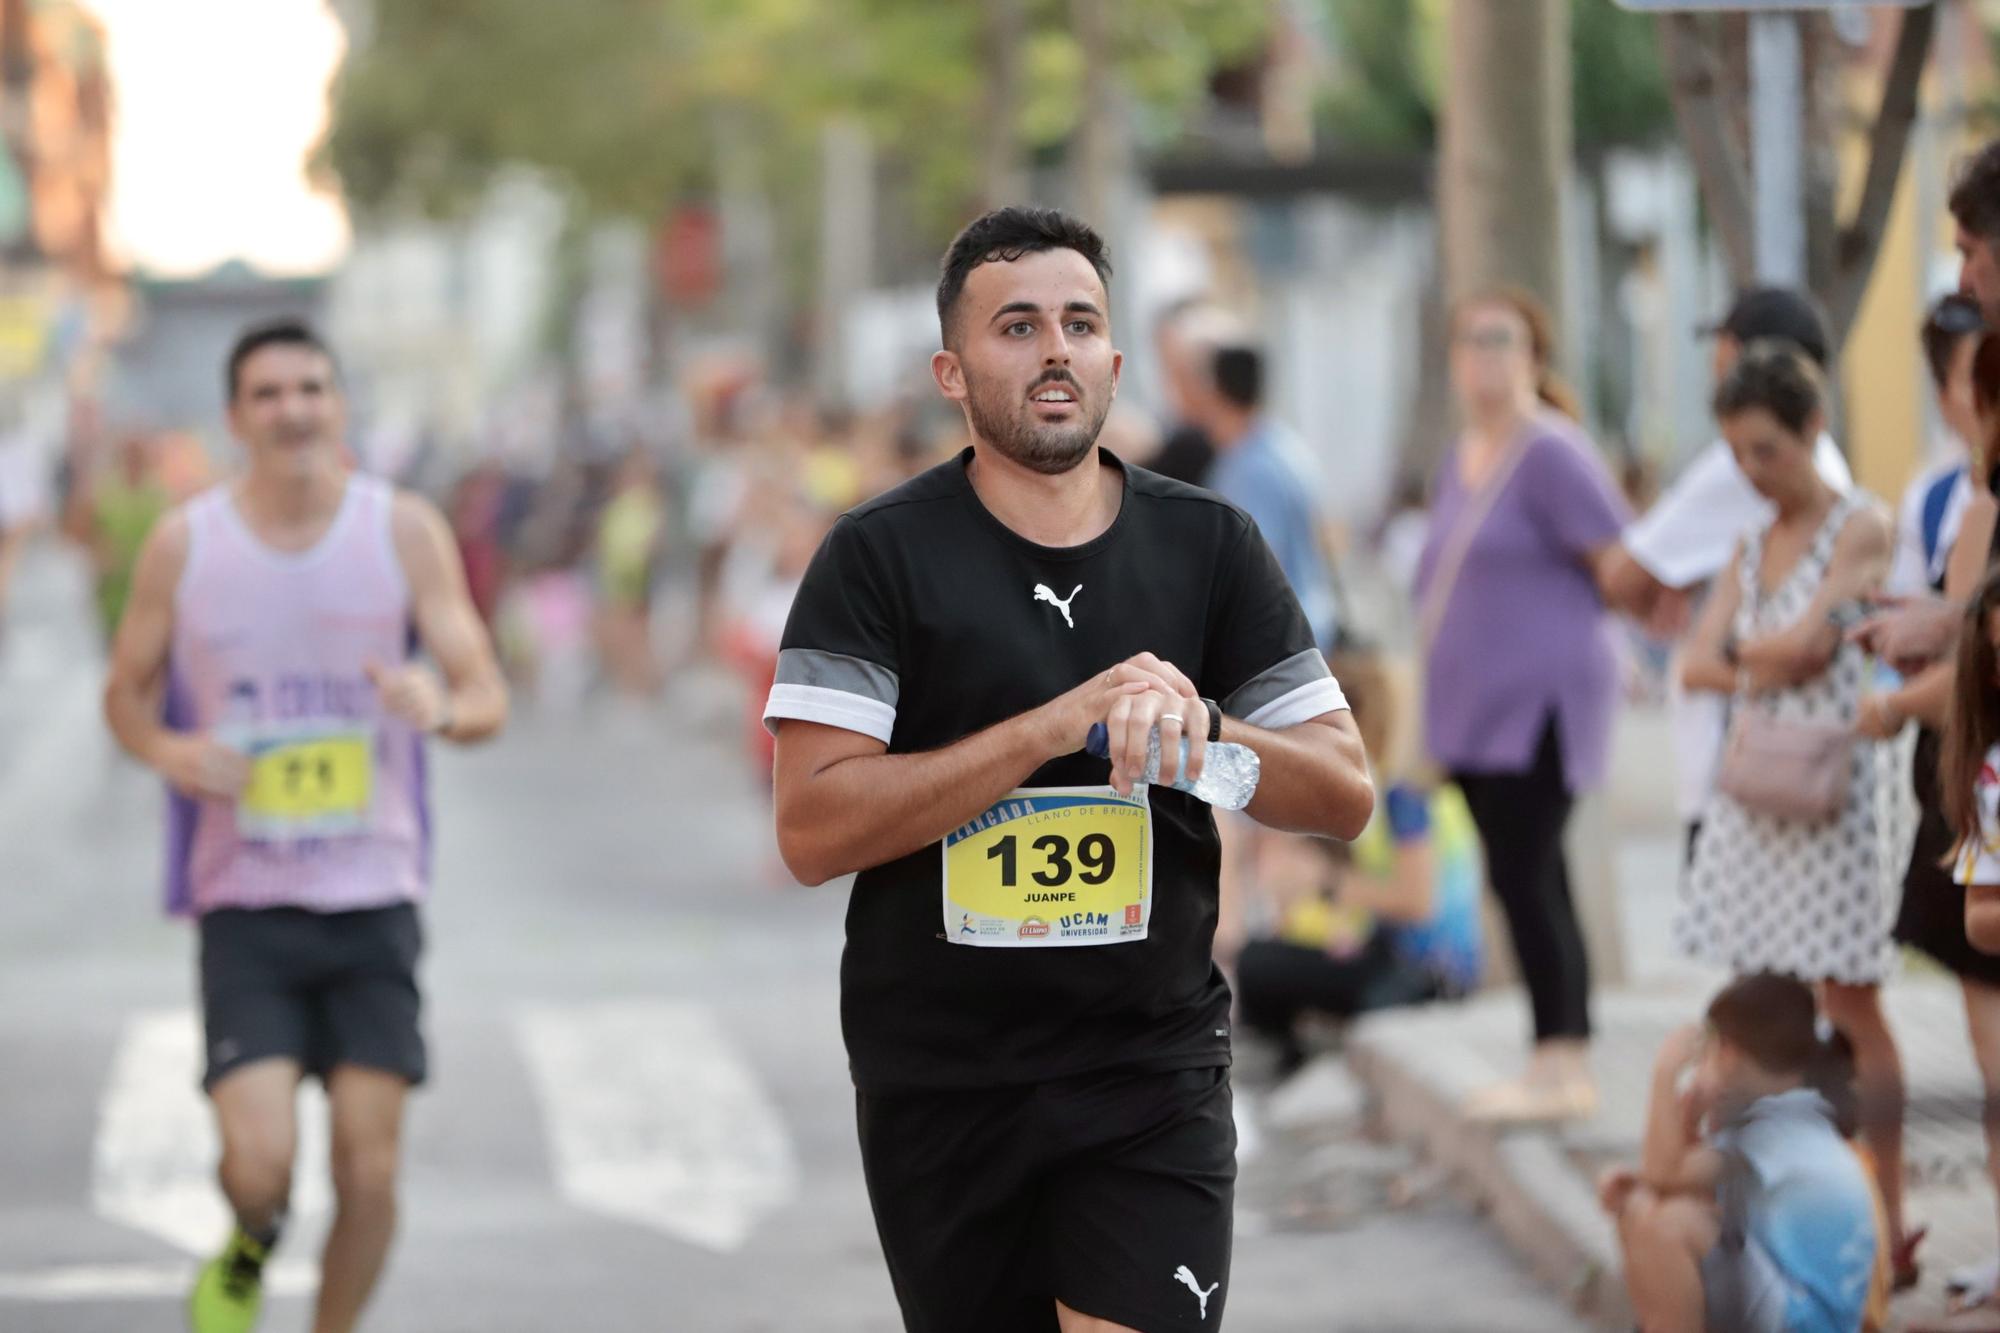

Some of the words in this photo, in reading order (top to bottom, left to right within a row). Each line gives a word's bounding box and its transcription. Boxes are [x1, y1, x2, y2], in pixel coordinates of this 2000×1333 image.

[1027, 809, 1071, 825] LLANO
[1080, 808, 1094, 816] DE
[1103, 807, 1145, 819] BRUJAS
[987, 833, 1116, 887] 139
[1024, 893, 1076, 902] JUANPE
[1060, 912, 1109, 928] UCAM
[1061, 928, 1108, 937] UNIVERSIDAD
